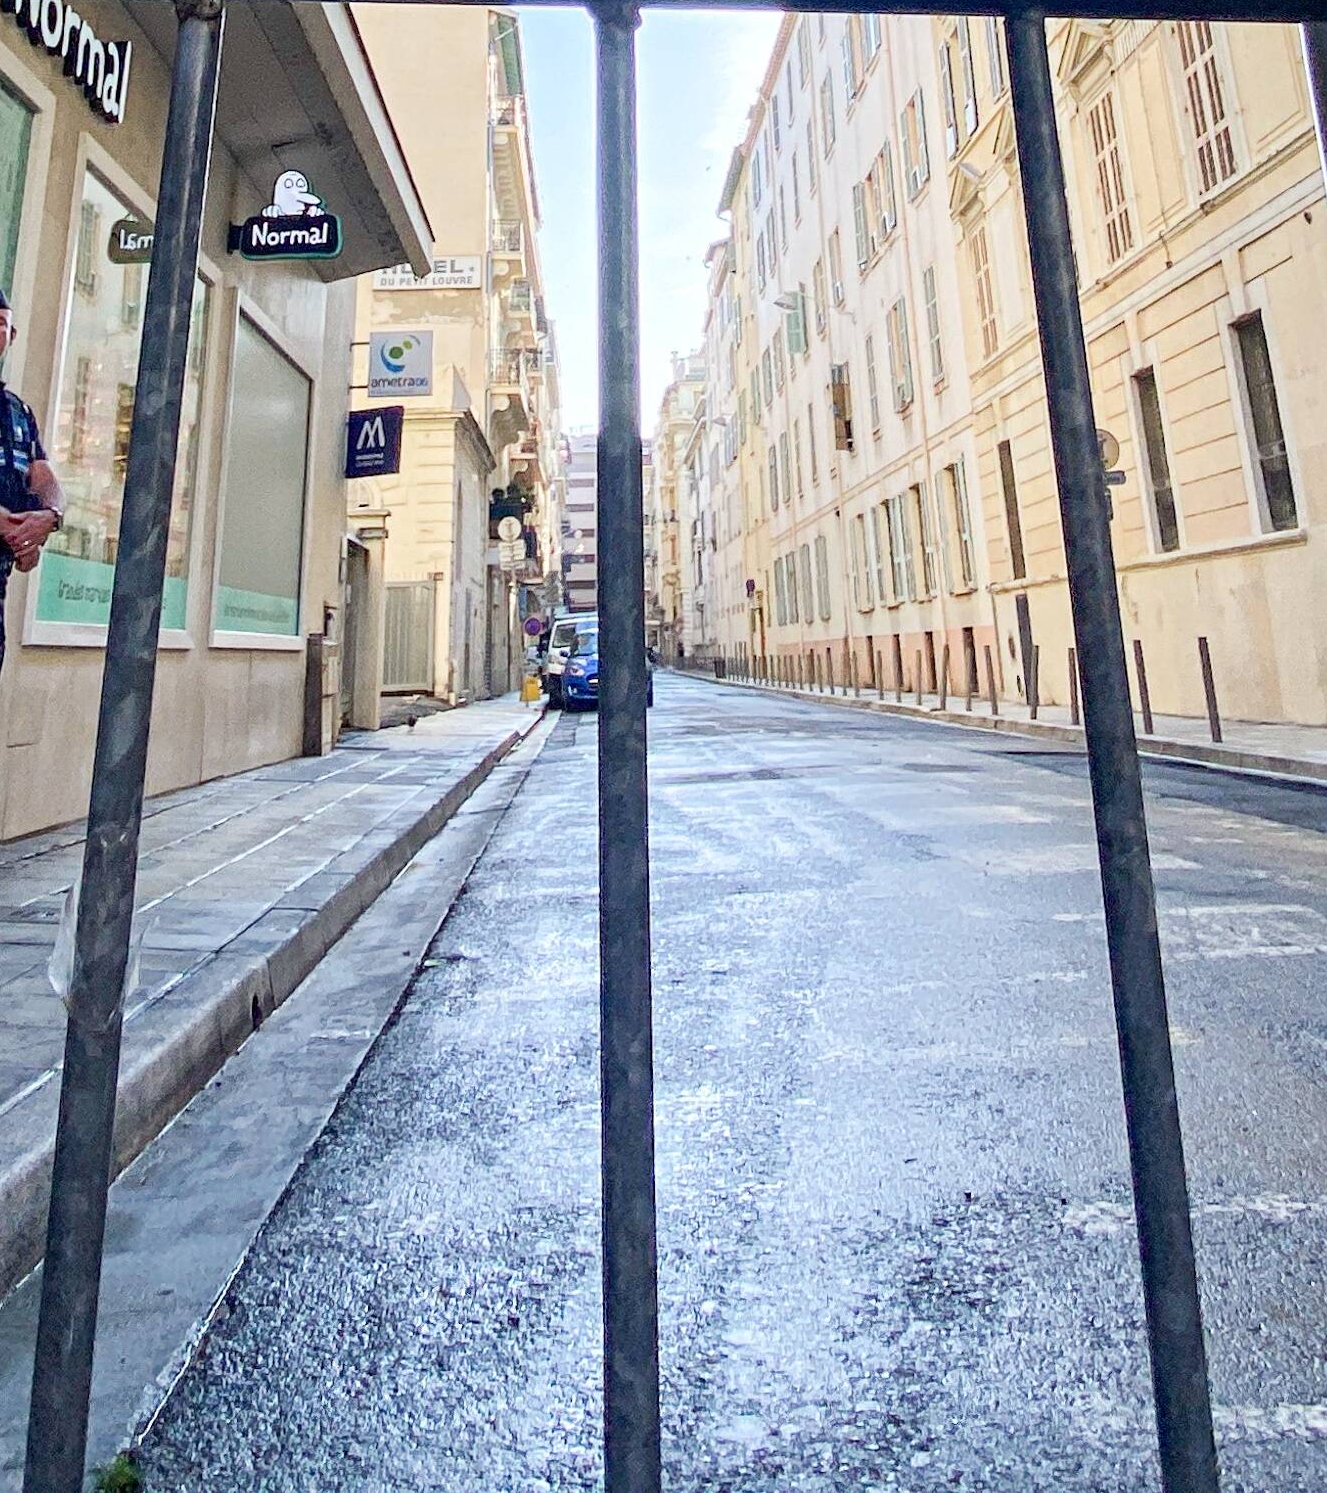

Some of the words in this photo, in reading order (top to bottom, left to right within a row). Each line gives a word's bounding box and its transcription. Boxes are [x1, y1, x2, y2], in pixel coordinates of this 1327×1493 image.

[251, 222, 329, 247] Normal
[380, 278, 394, 286] DU
[433, 276, 473, 285] LOUVRE
